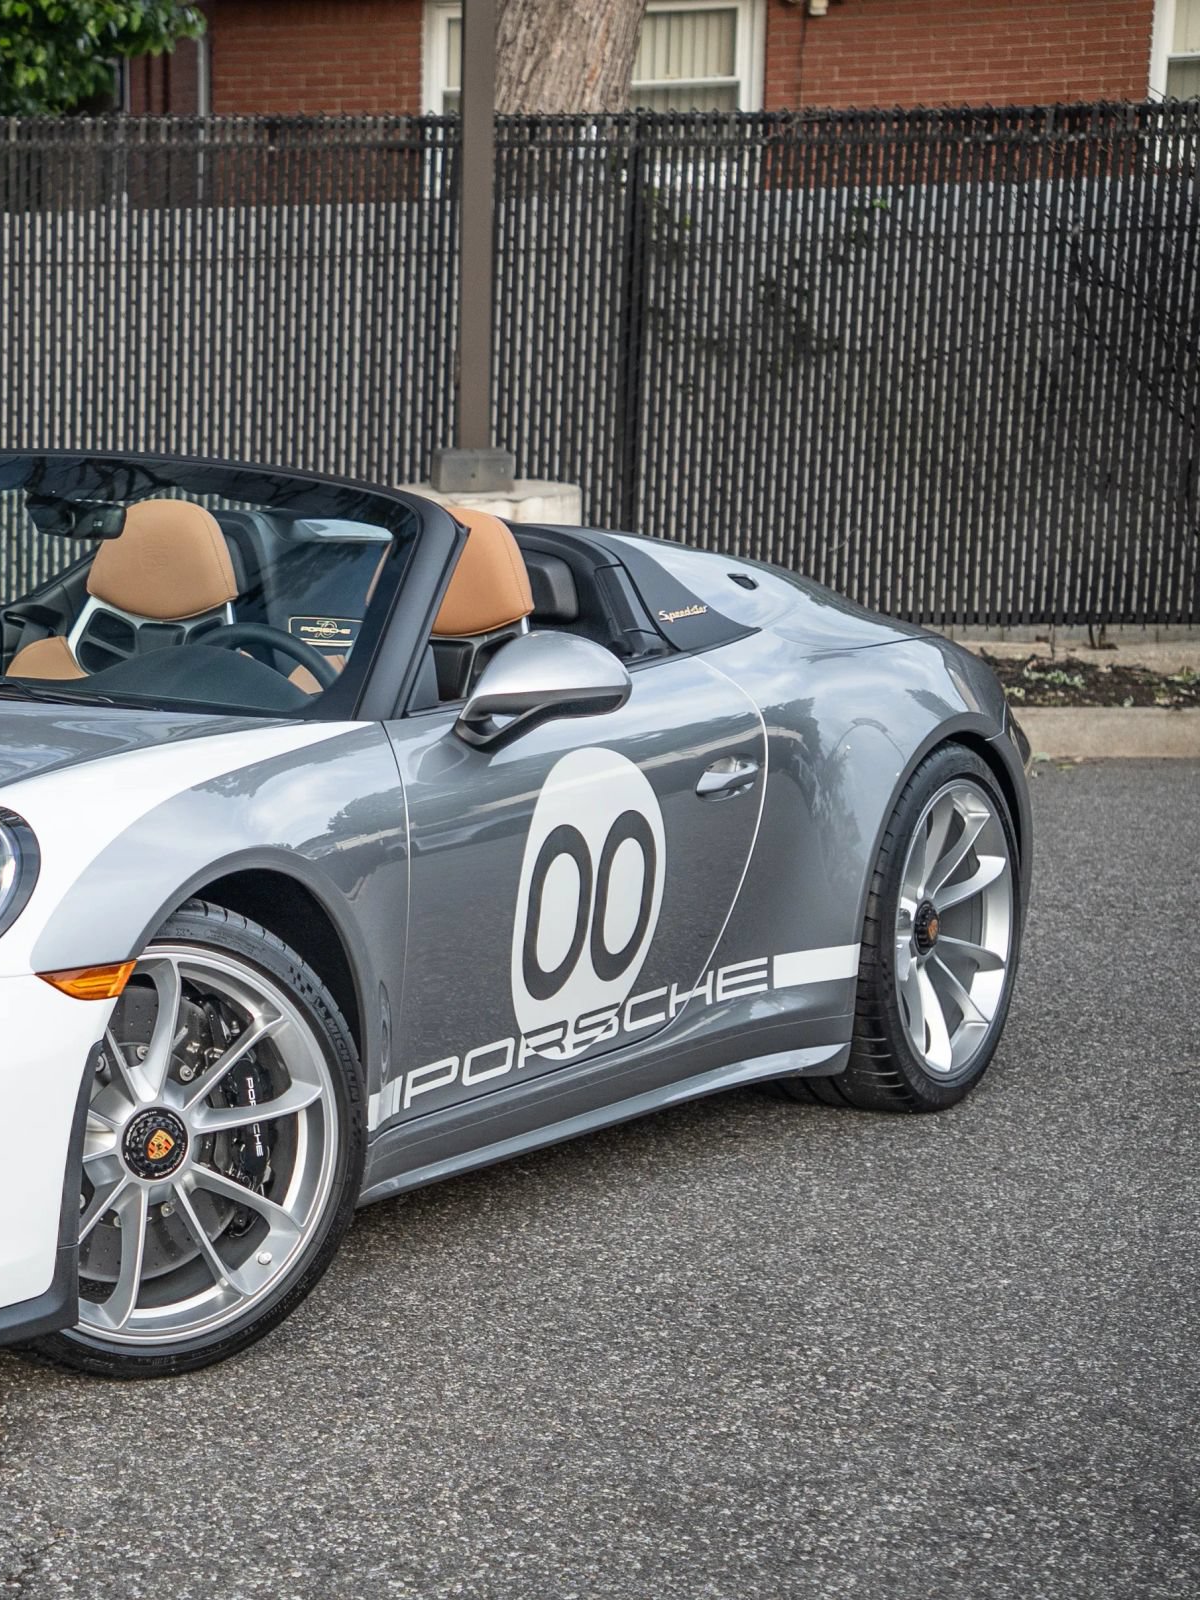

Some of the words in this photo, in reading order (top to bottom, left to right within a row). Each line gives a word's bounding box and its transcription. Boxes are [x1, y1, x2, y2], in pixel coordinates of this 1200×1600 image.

[300, 626, 351, 634] PORSCHE
[658, 604, 708, 622] Speedster
[522, 809, 656, 1001] 00
[324, 1017, 360, 1102] MICHELIN
[404, 957, 768, 1109] PORSCHE
